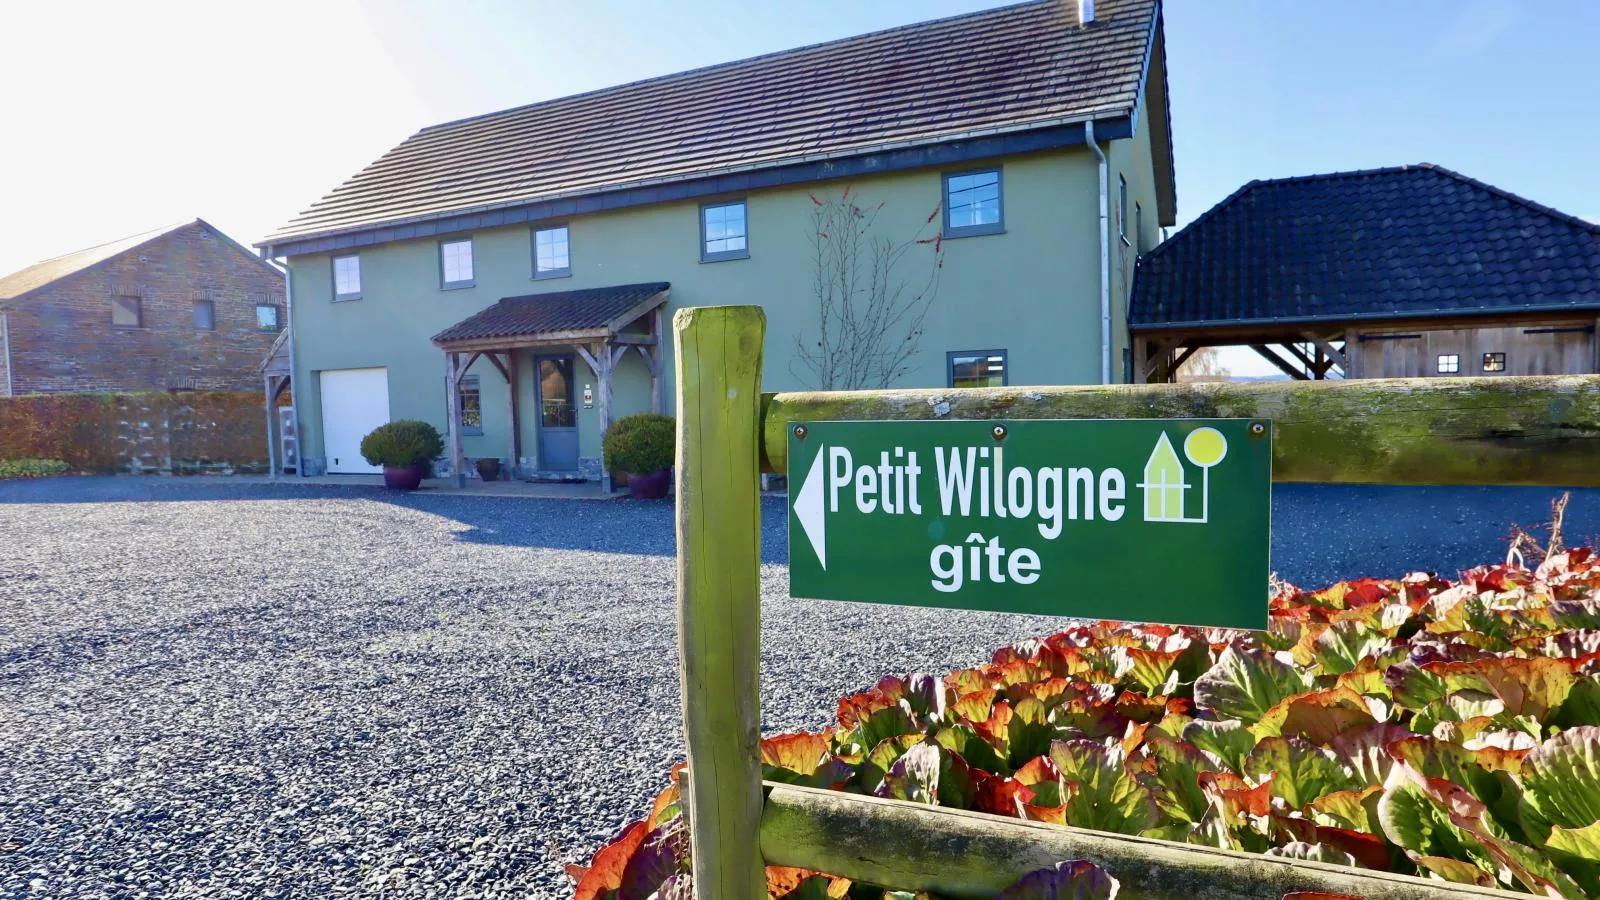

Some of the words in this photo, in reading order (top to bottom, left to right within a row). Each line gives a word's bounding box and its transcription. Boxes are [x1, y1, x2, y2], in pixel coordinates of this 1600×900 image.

[829, 446, 921, 515] Petit
[934, 446, 1126, 540] Wilogne
[930, 532, 1041, 593] gîte
